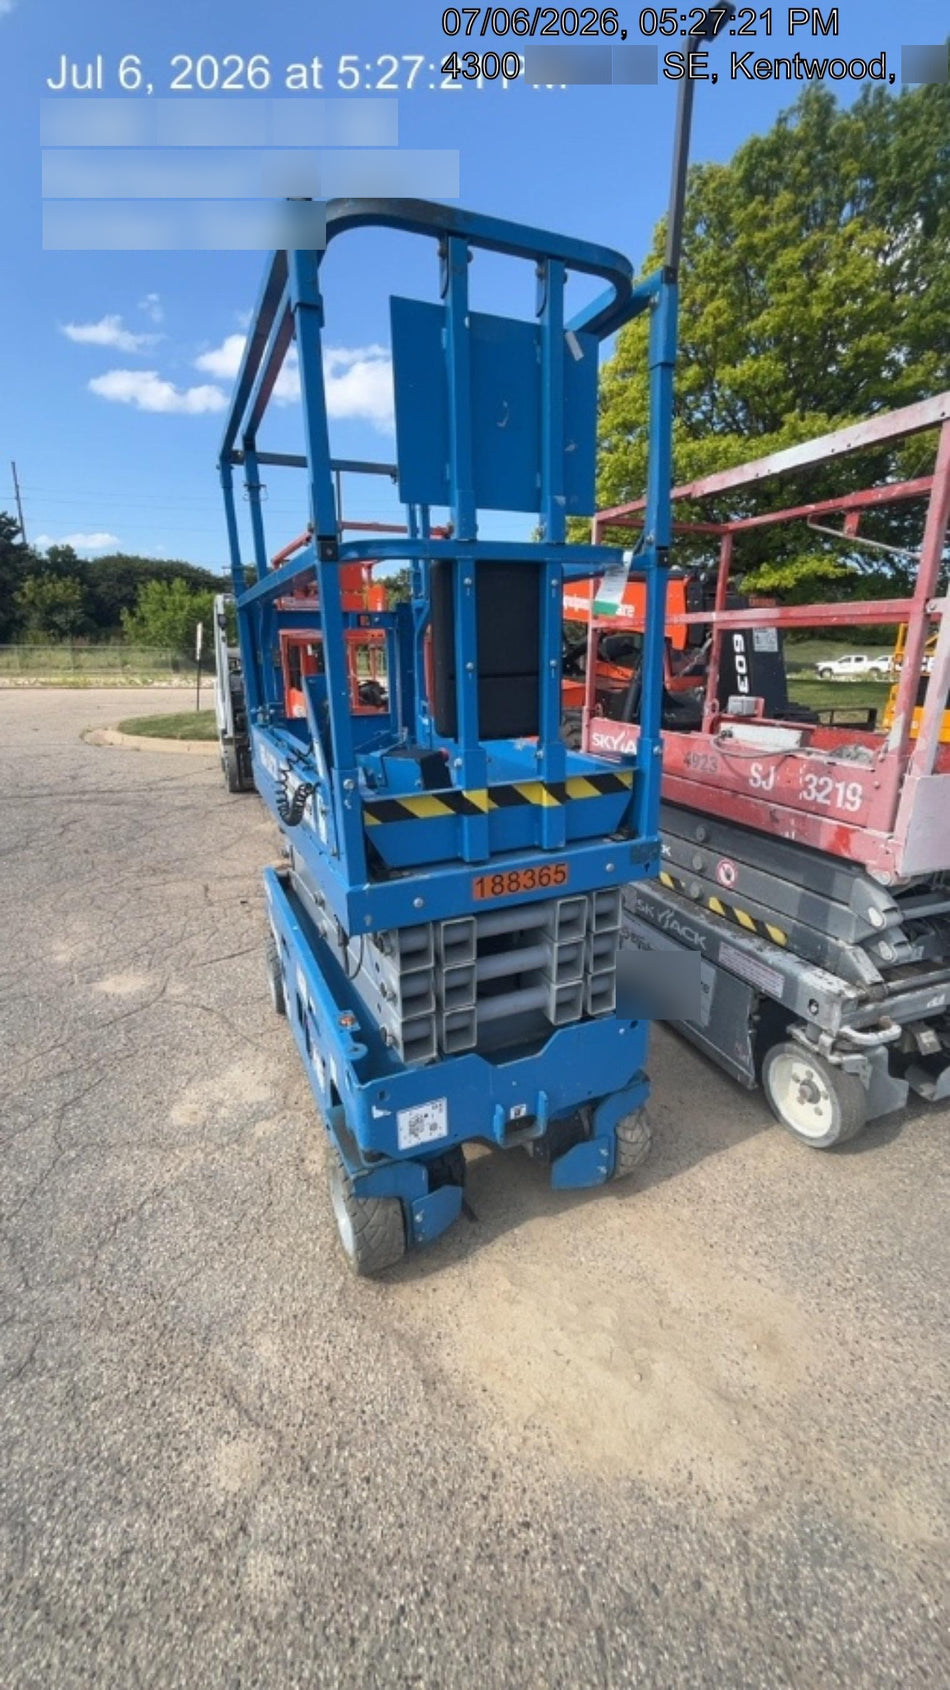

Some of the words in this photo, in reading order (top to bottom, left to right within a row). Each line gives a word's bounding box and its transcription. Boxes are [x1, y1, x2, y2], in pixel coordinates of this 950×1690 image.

[732, 633, 749, 694] 603
[802, 773, 864, 812] 3219
[475, 863, 567, 898] 188365
